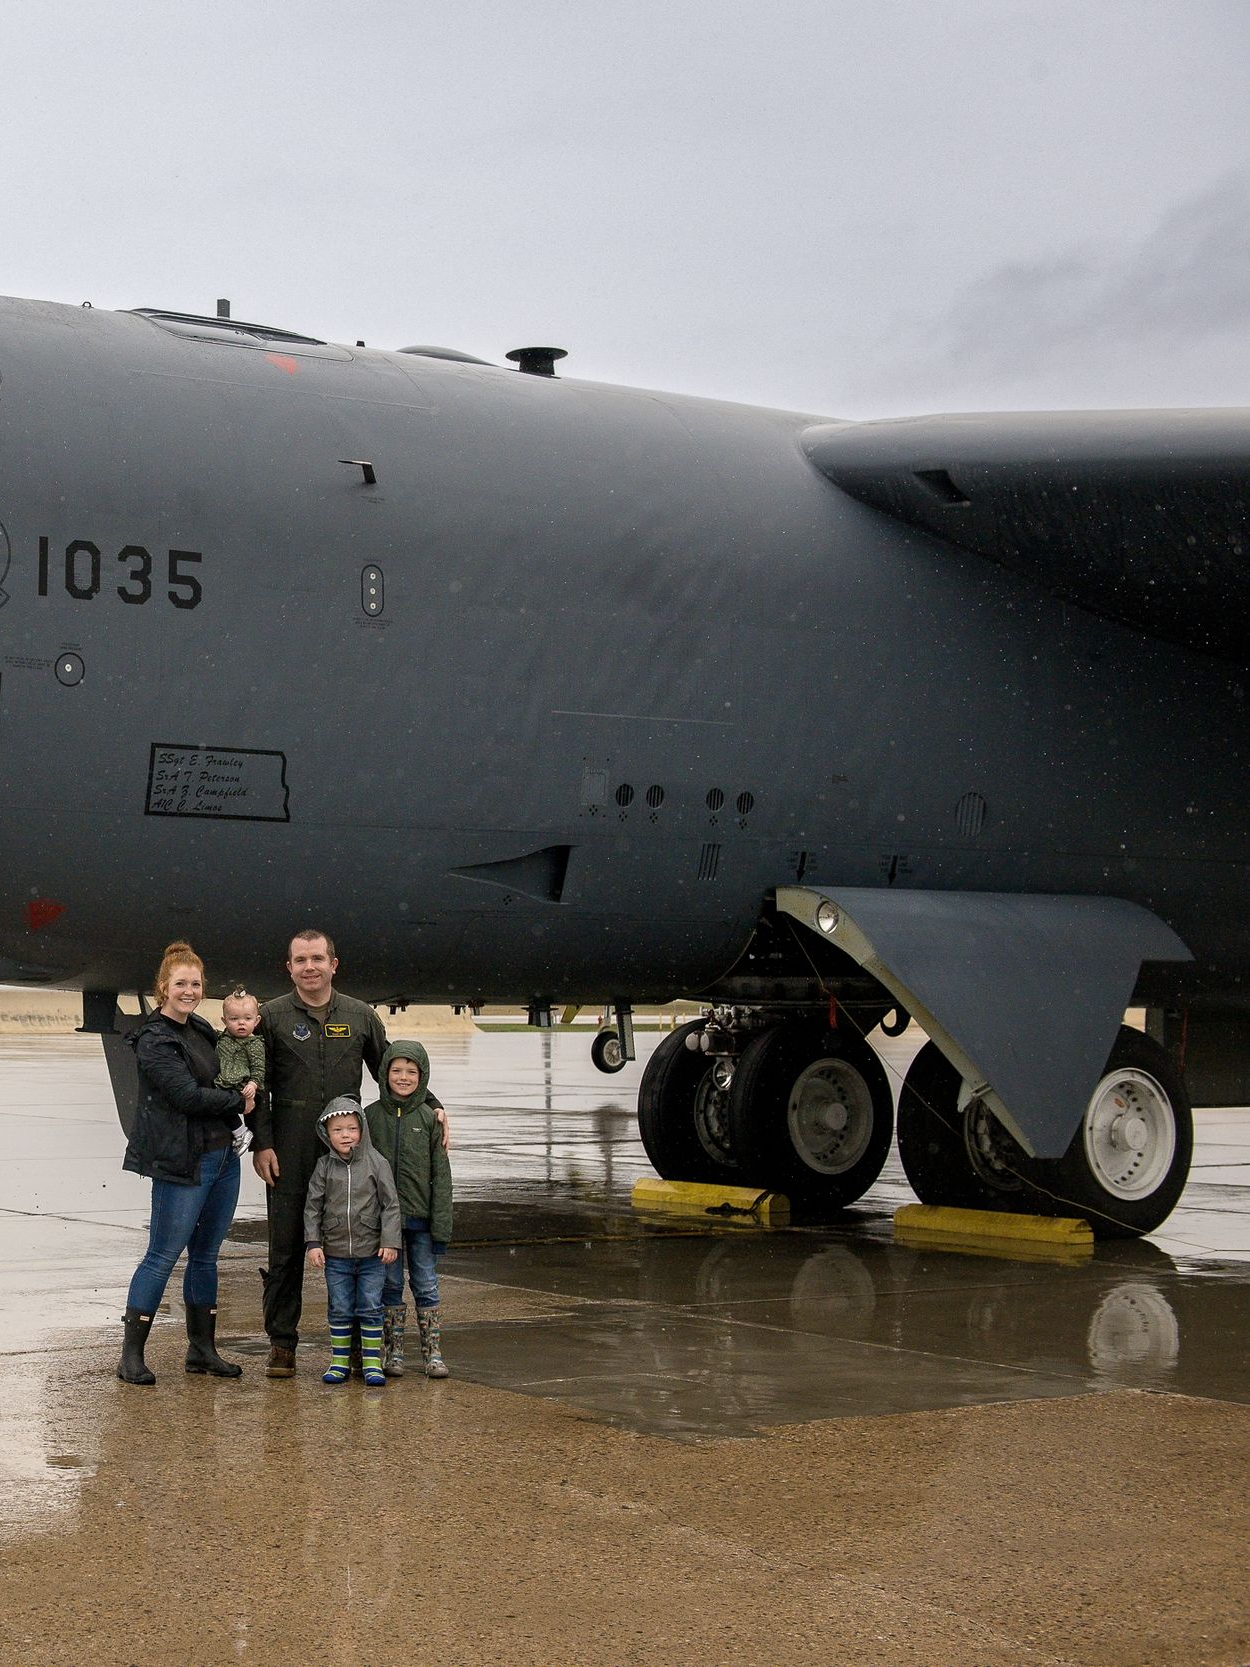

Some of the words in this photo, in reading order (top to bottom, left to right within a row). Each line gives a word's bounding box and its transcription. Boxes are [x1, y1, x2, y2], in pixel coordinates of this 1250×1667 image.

[38, 536, 202, 610] 1035
[158, 753, 185, 767] SSgt
[198, 771, 240, 783] Peterson
